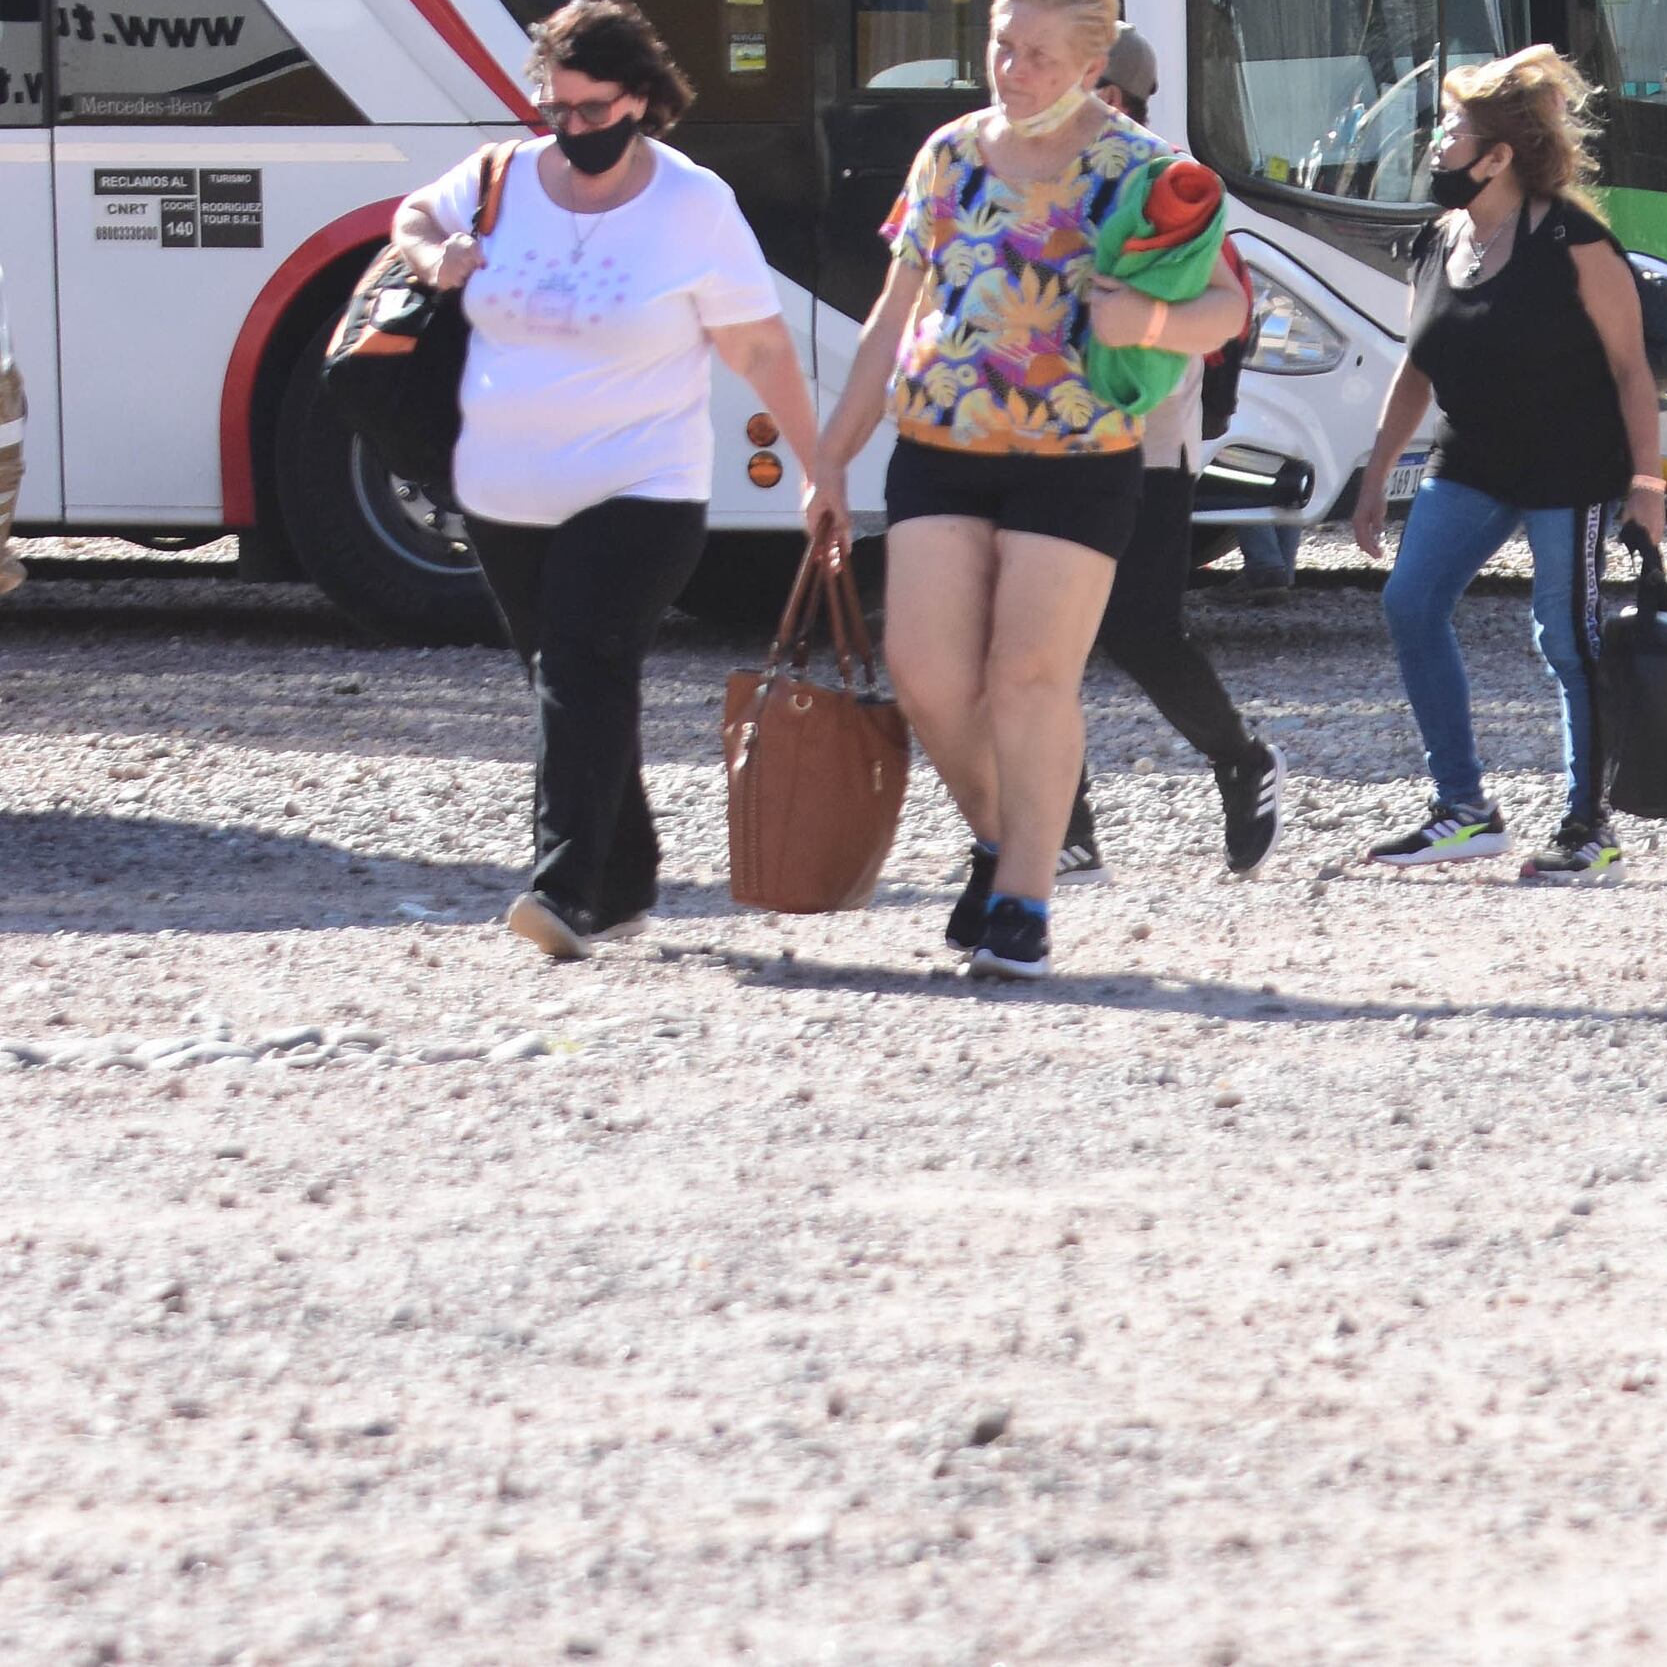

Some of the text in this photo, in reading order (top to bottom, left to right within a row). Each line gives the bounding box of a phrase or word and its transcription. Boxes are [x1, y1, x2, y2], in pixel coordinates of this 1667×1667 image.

[80, 96, 213, 115] Mercedes-Benz
[101, 176, 188, 187] RECLAMOS AL
[107, 203, 149, 215] CNRT
[163, 201, 196, 211] COCHE
[165, 221, 194, 236] 140
